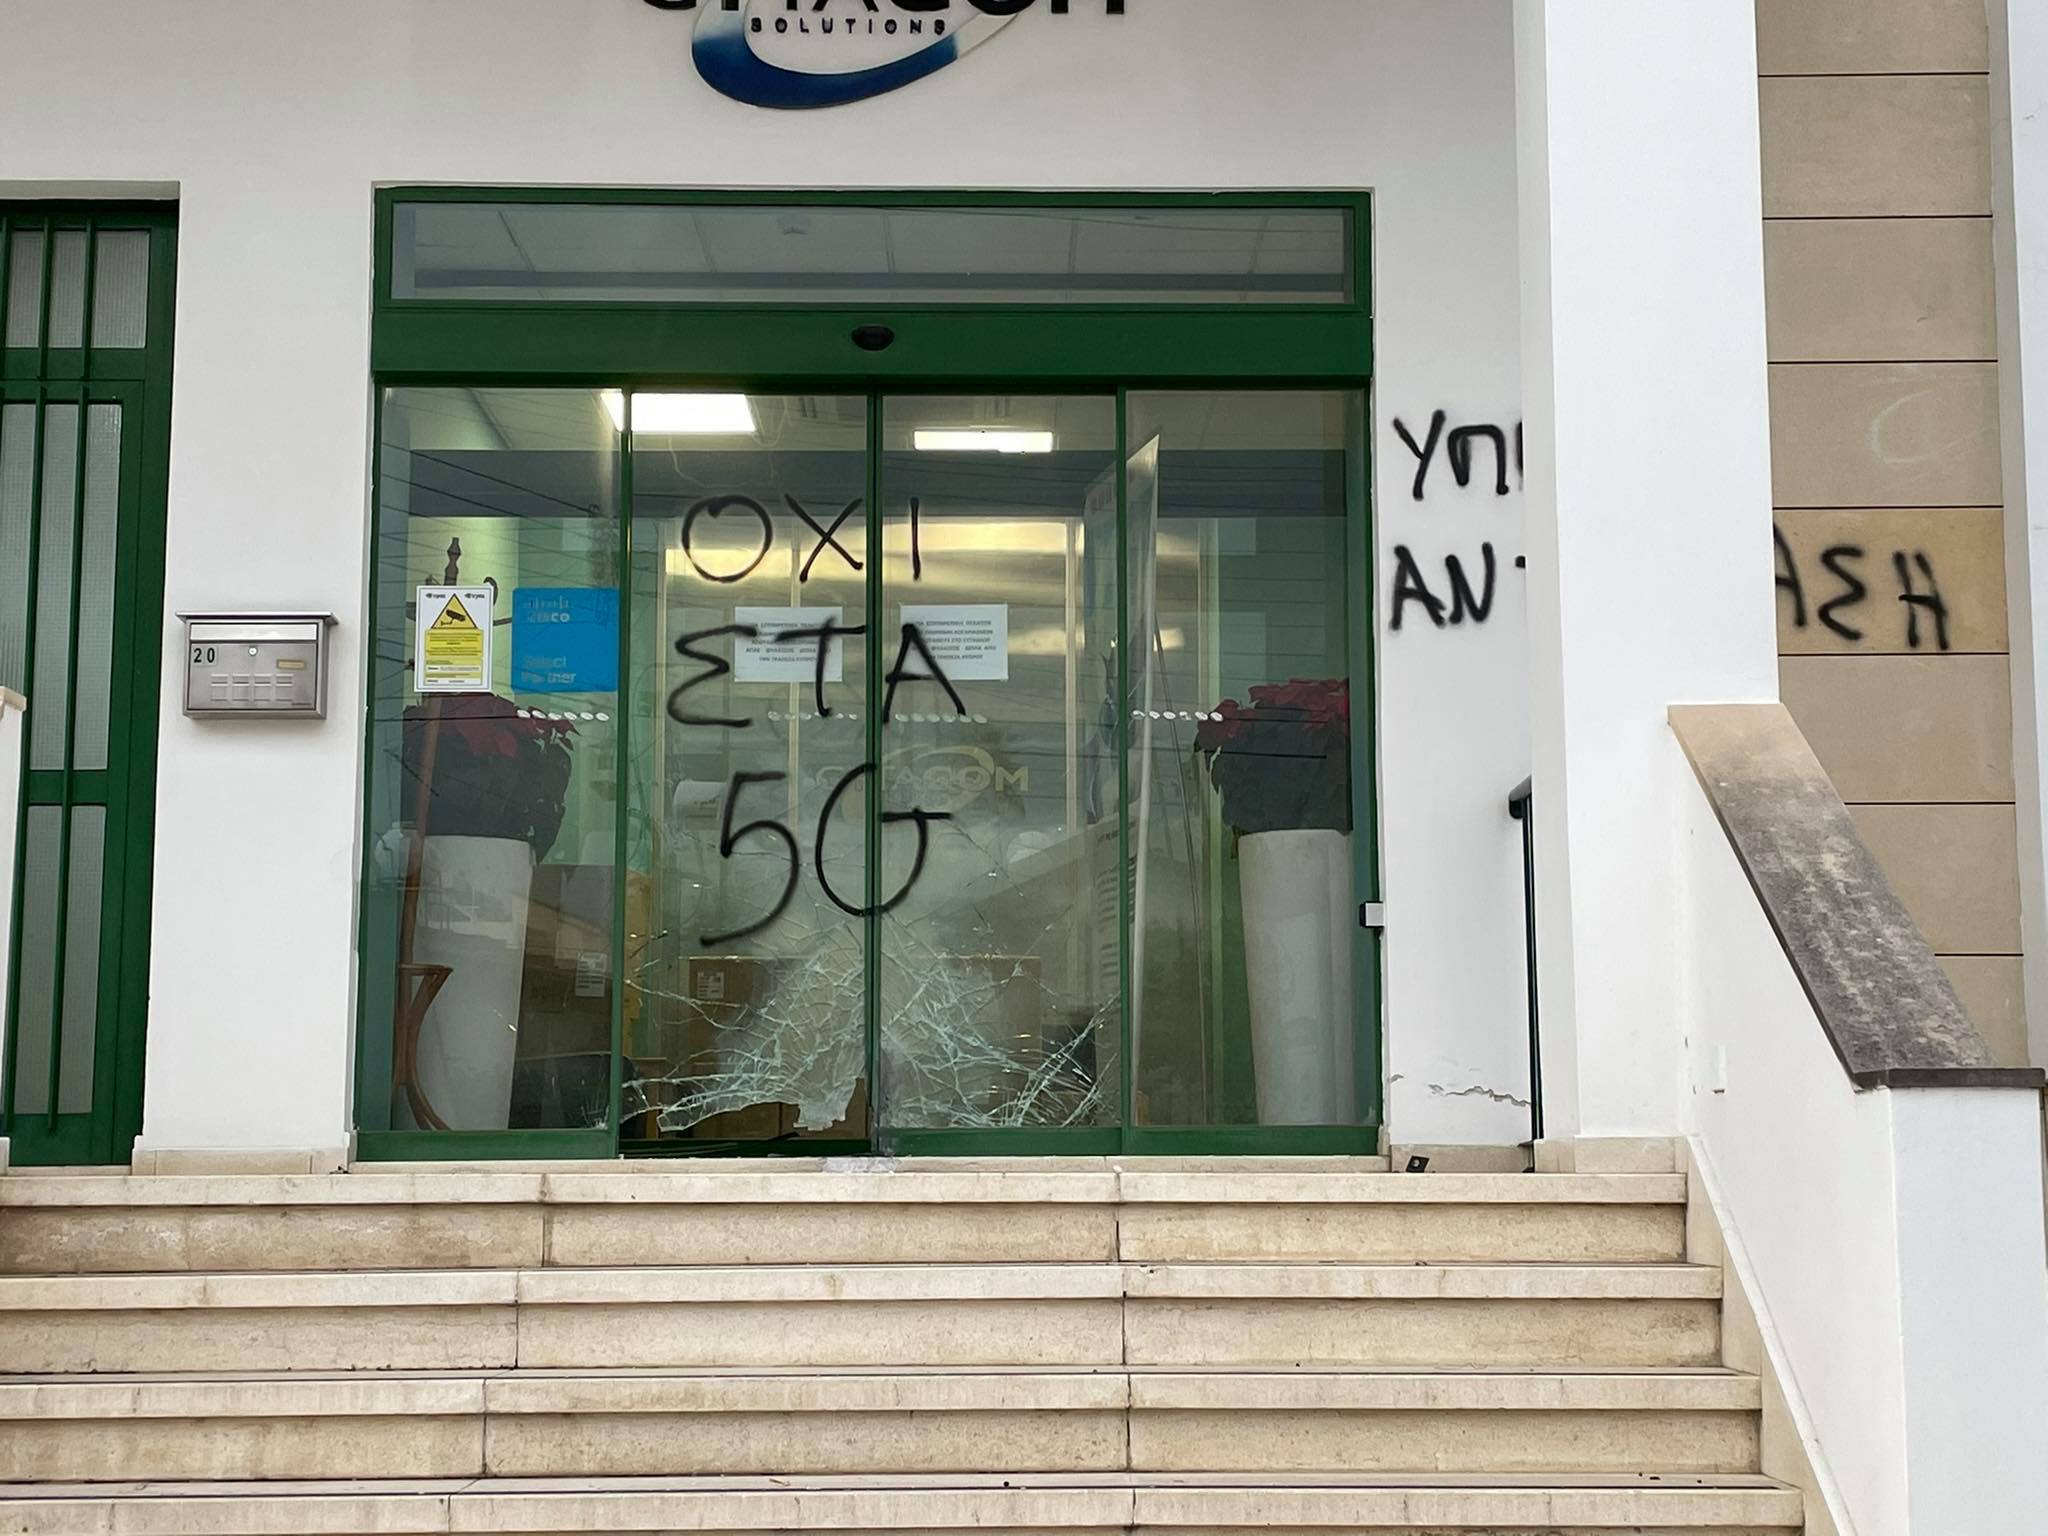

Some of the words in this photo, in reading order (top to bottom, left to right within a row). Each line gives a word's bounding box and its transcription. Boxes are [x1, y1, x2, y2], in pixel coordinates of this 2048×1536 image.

[751, 17, 946, 35] SOLUTIONS
[1393, 409, 1524, 500] ΥΠ
[682, 493, 922, 583] ΟΧΙ
[1389, 542, 1526, 631] ΑΝ
[193, 648, 215, 663] 20
[815, 766, 1030, 793] CTACOM
[700, 763, 953, 947] 5G
